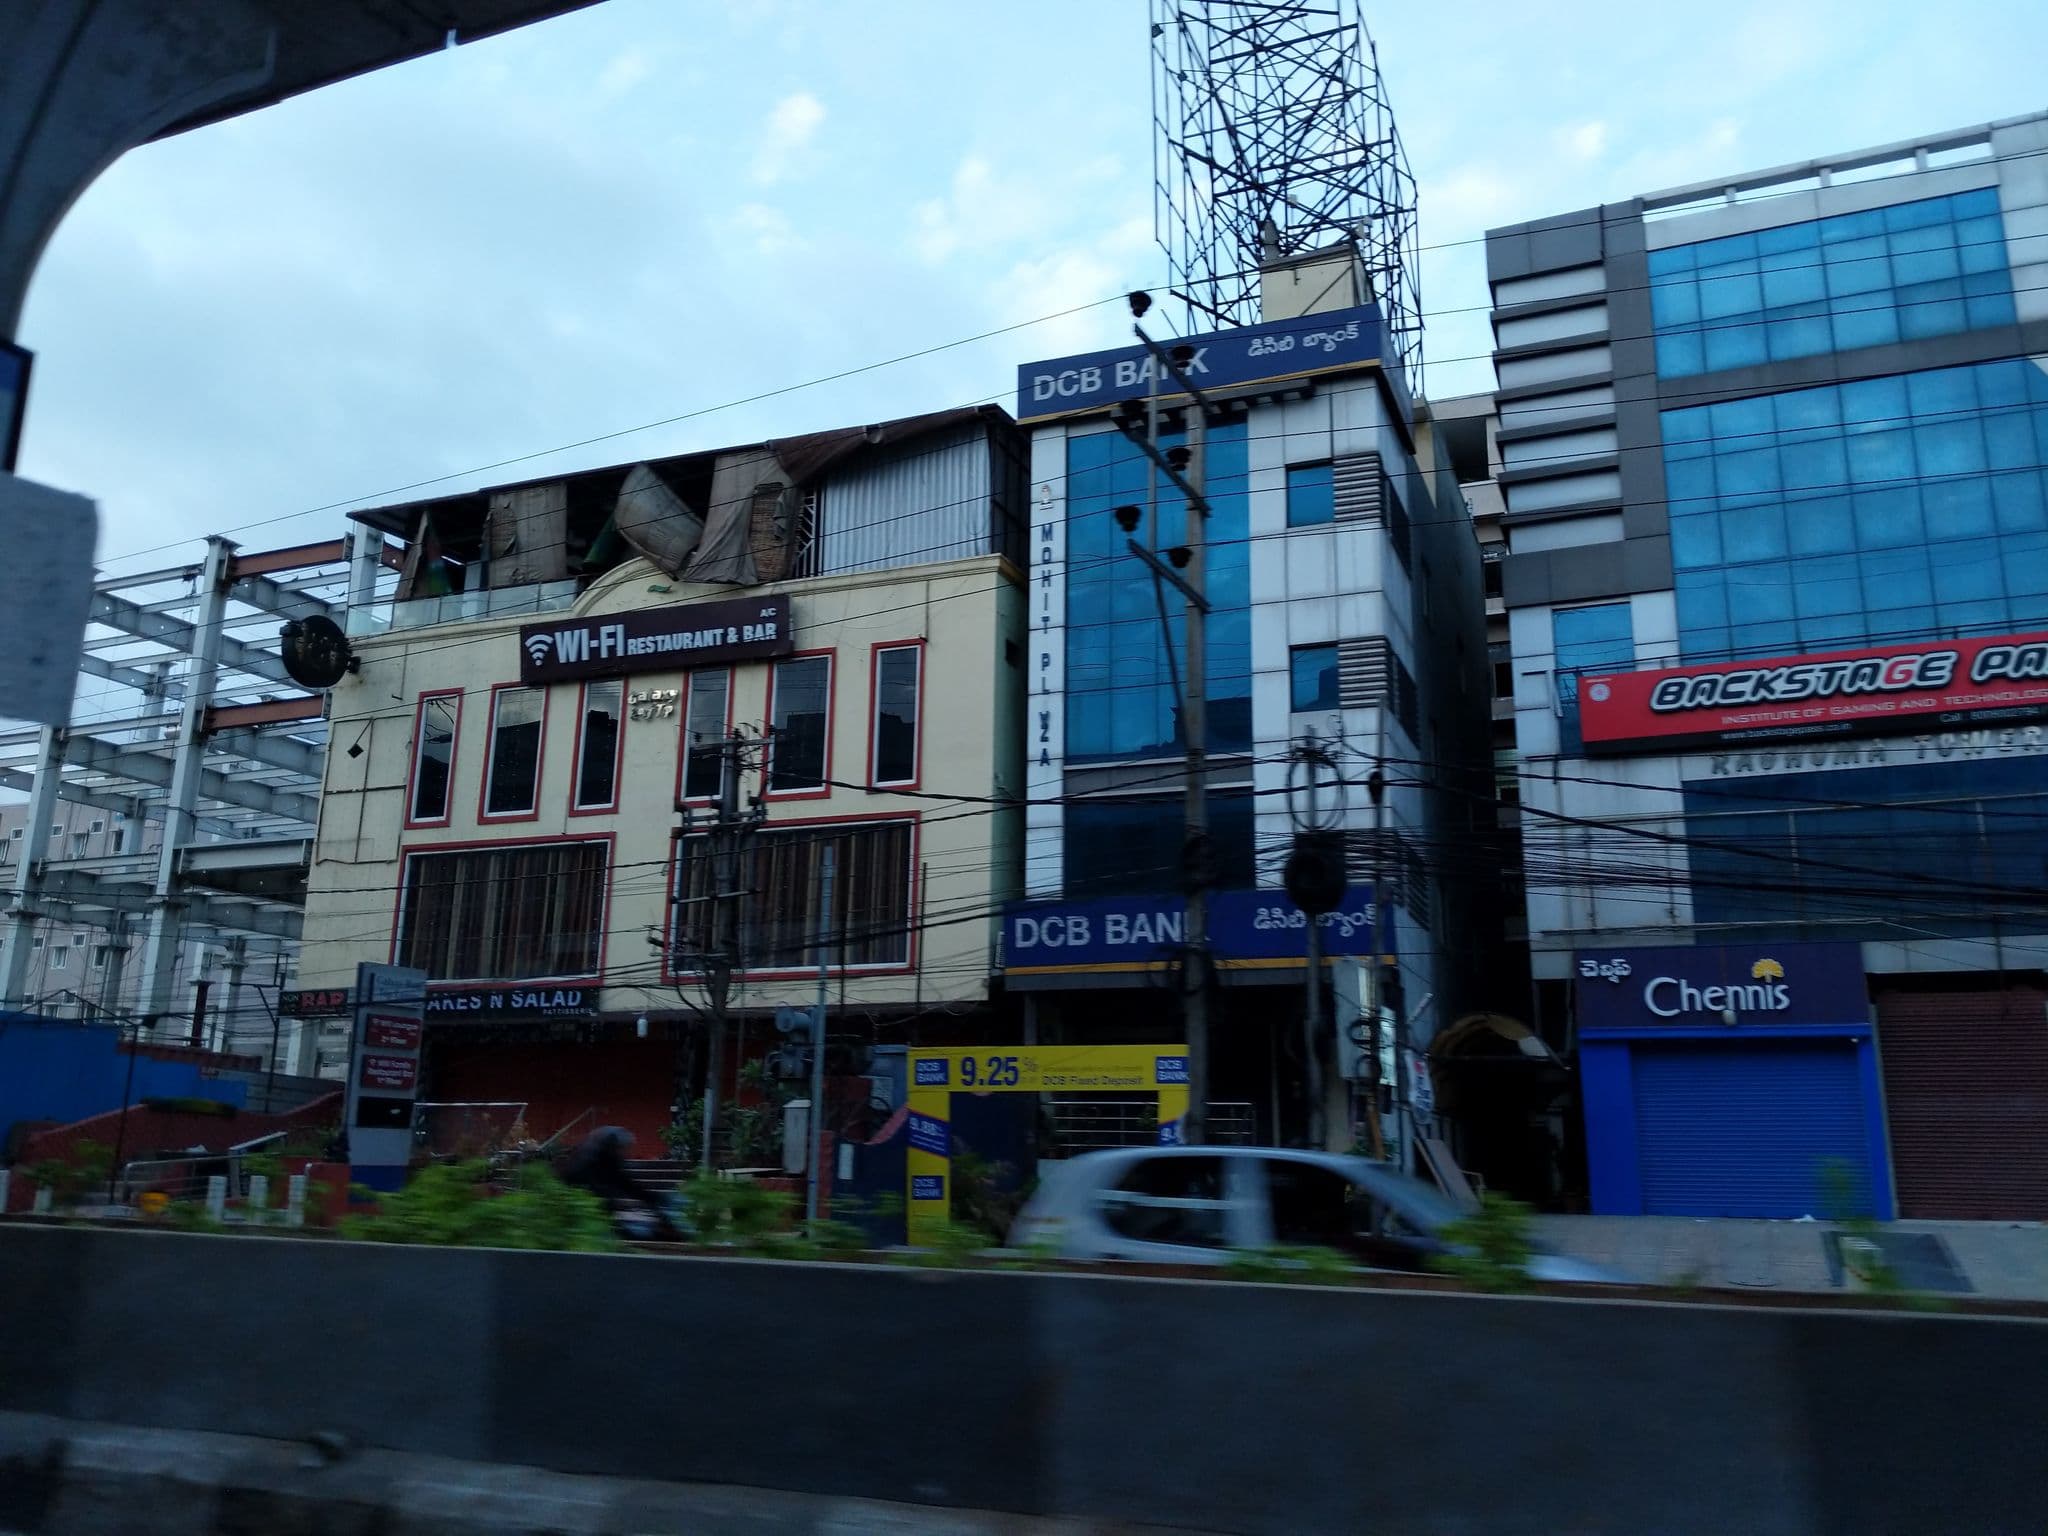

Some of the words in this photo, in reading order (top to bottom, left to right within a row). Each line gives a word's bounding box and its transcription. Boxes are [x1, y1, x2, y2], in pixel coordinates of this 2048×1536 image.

[1033, 367, 1102, 402] DCB
[1041, 523, 1054, 634] MOHIT
[554, 623, 625, 664] WI-FI
[627, 628, 724, 656] RESTAURANT
[727, 626, 739, 645] &
[743, 622, 778, 642] BAR
[1649, 649, 1959, 713] BACKSTAGE
[1971, 642, 2048, 684] PA
[1721, 710, 1801, 724] INSTITUTE
[1803, 708, 1826, 718] OF
[1830, 701, 1896, 715] GAMING
[1900, 698, 1937, 709] AND
[1014, 916, 1092, 949] DCB
[1104, 911, 1212, 945] BAN
[426, 993, 482, 1011] AKES
[488, 991, 504, 1009] N
[510, 989, 582, 1009] SALAD
[1643, 976, 1791, 1017] Chennis
[961, 1056, 1019, 1086] 9.25
